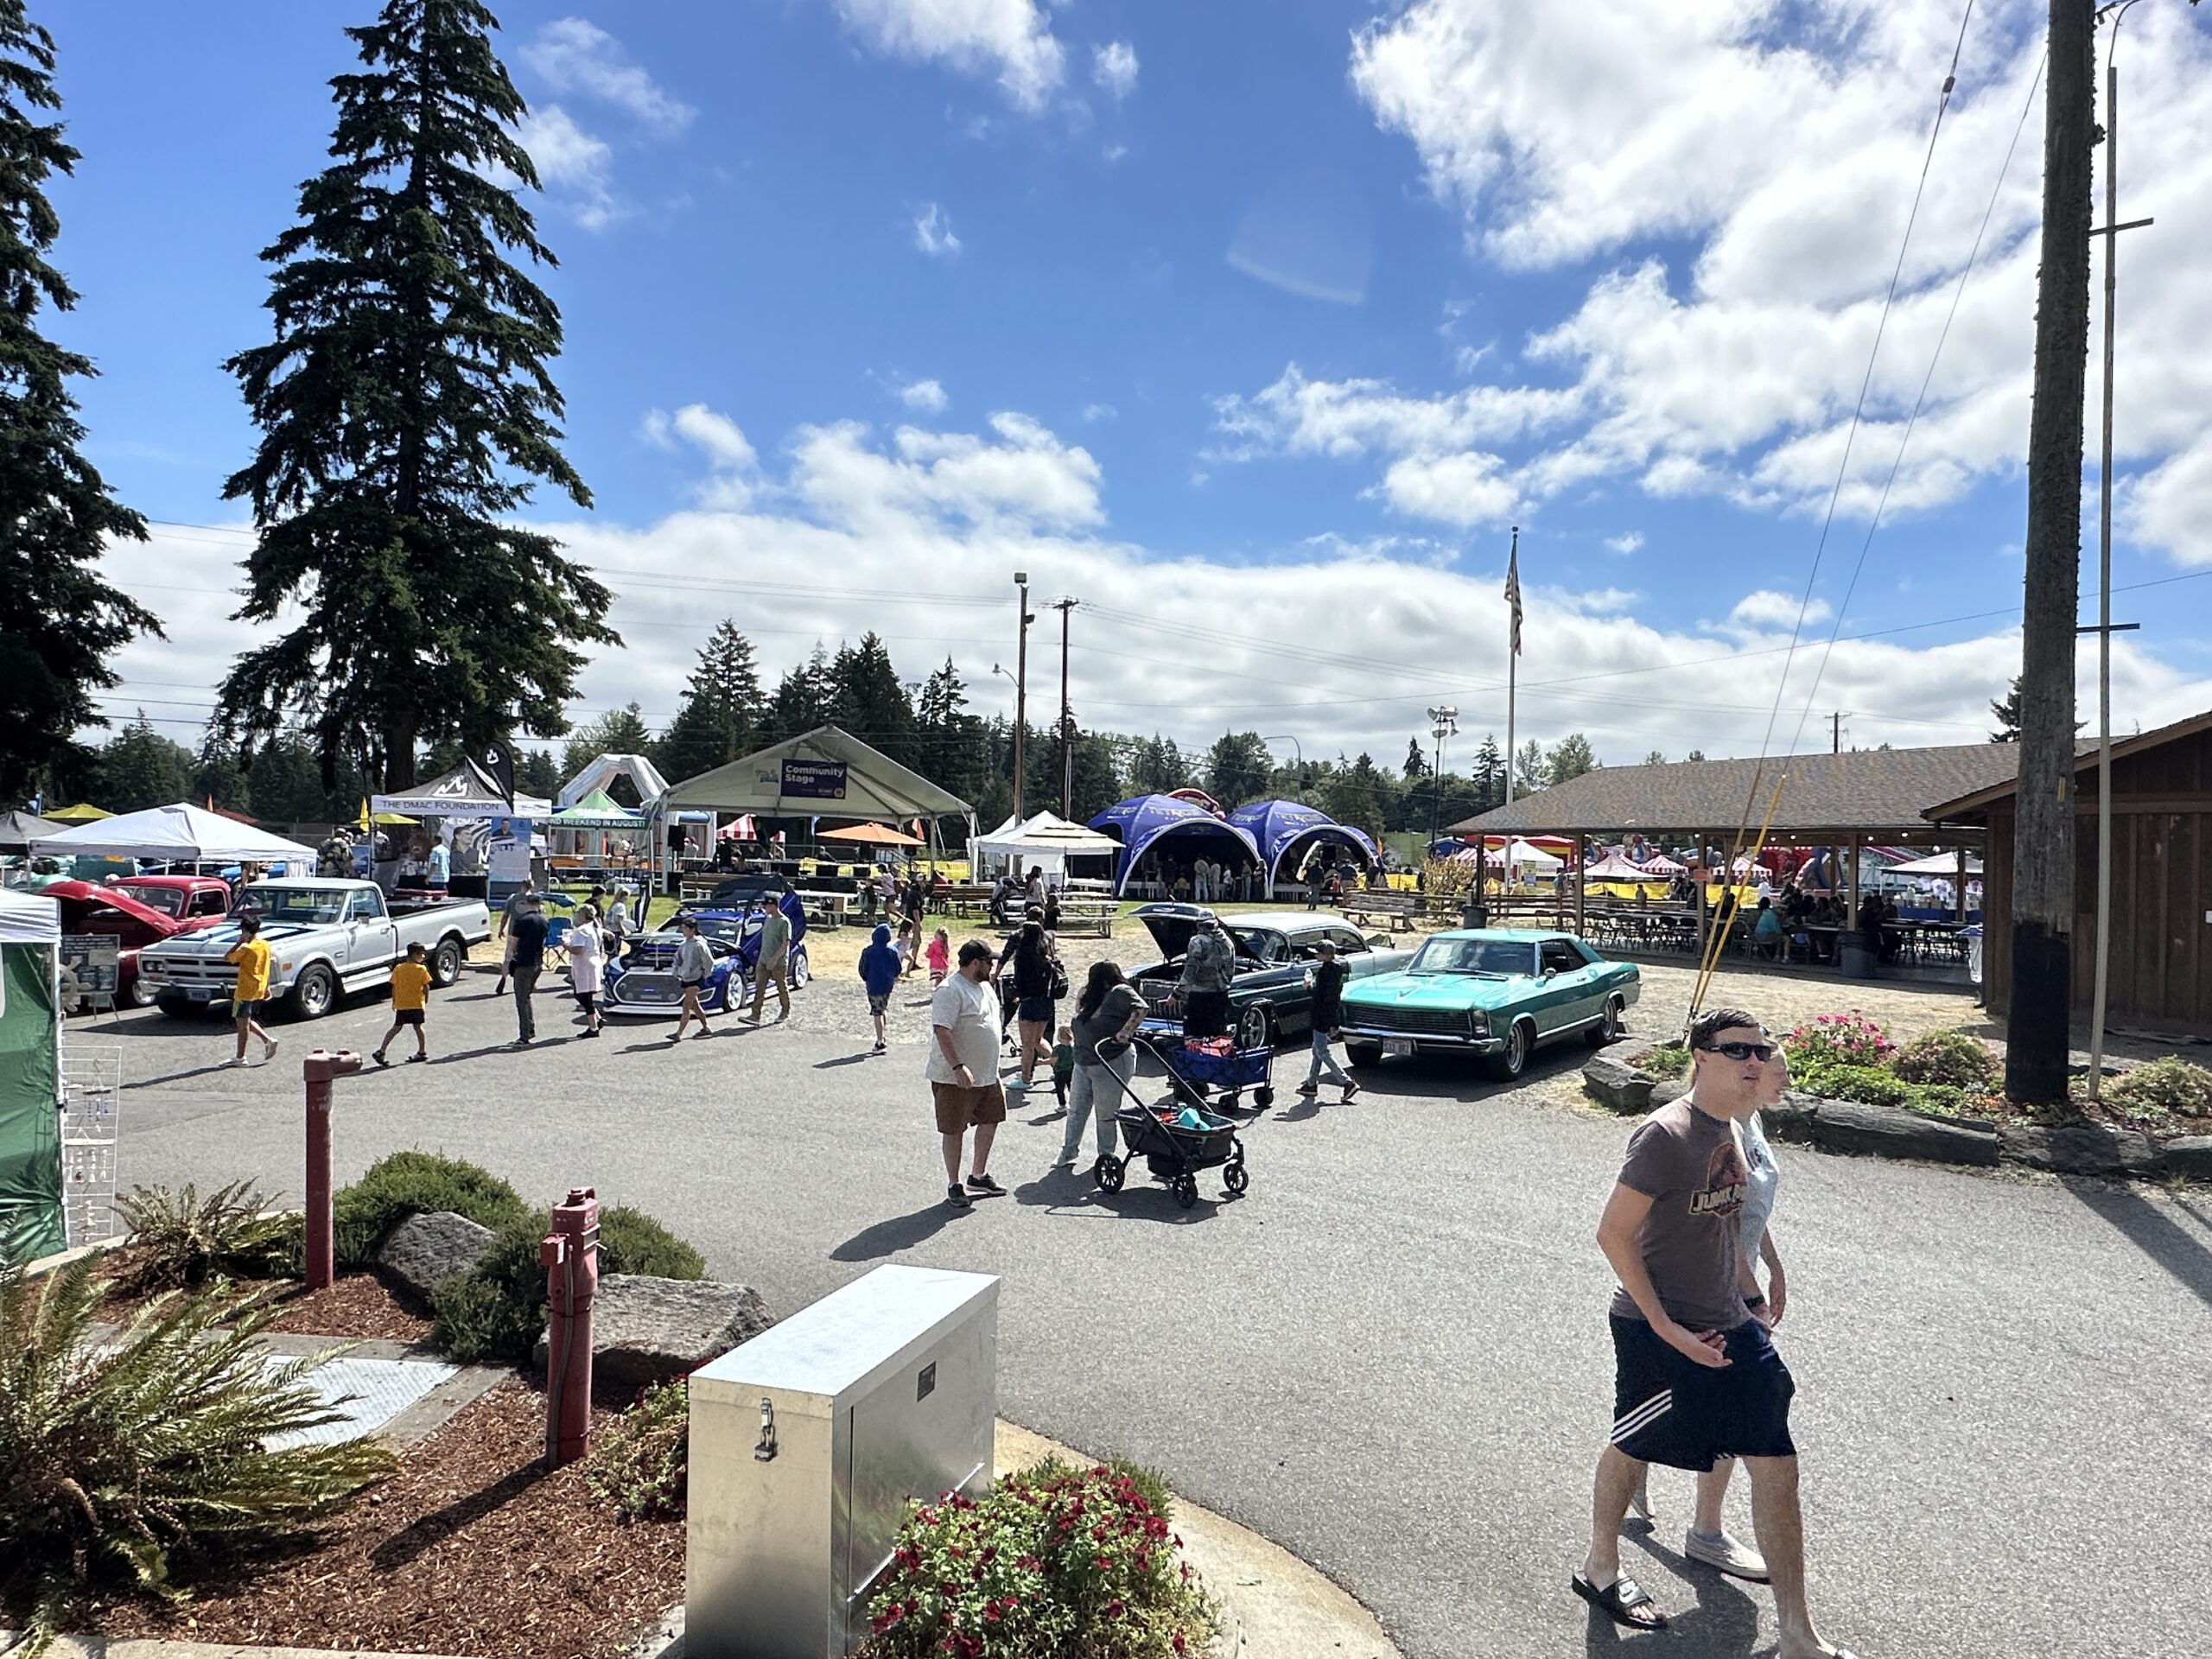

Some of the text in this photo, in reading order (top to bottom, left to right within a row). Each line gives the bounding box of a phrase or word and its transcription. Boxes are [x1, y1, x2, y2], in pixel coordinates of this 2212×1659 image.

[785, 765, 844, 778] Community
[785, 773, 816, 784] Stage
[404, 801, 433, 810] DMAC
[435, 802, 499, 810] FOUNDATION
[439, 817, 454, 825] THE
[563, 818, 601, 827] WEEKEND
